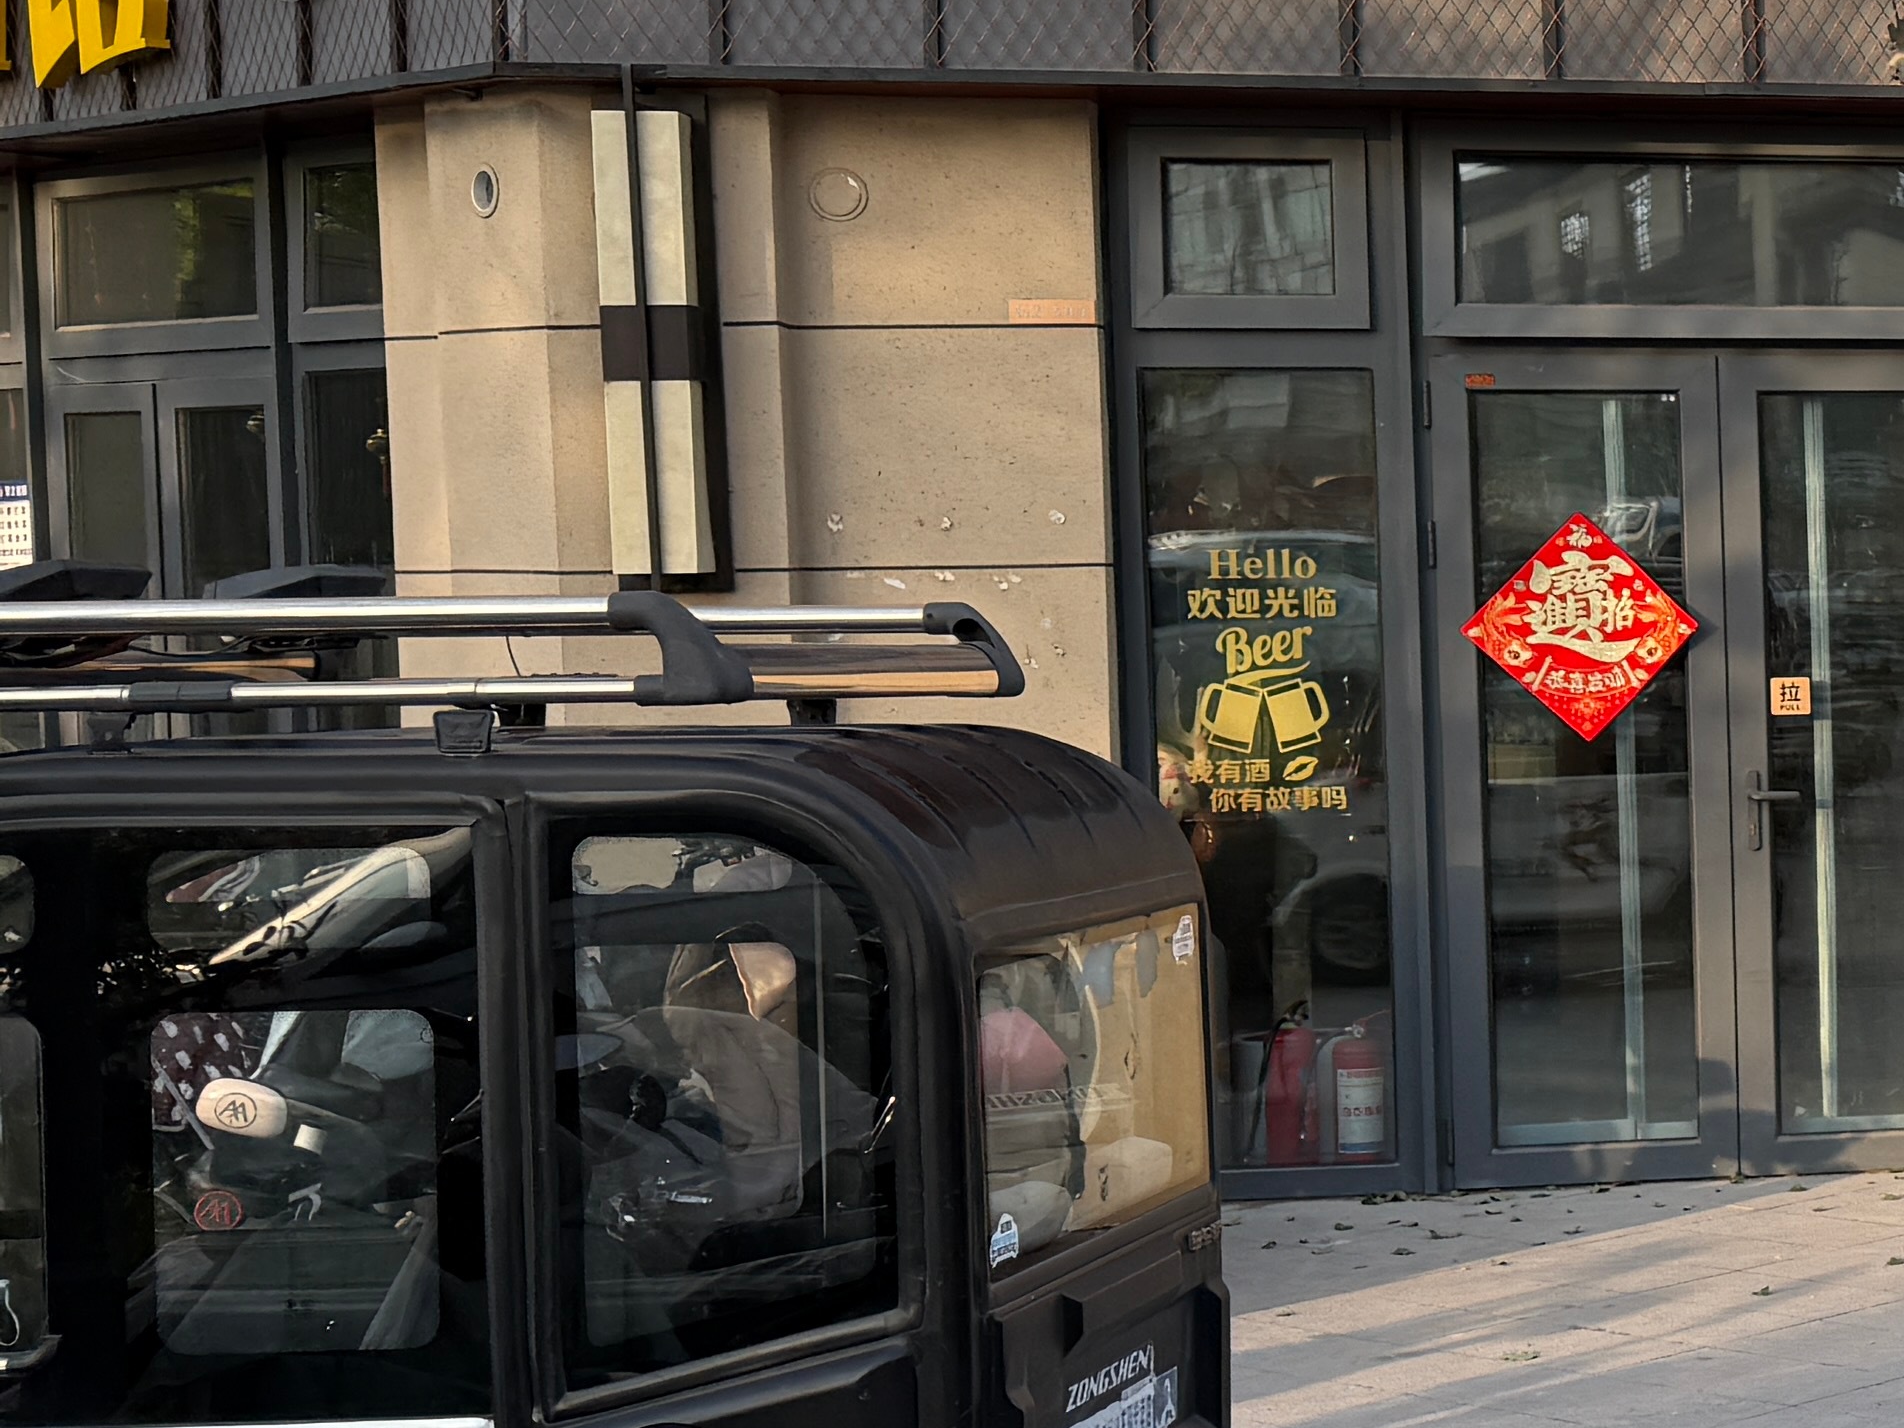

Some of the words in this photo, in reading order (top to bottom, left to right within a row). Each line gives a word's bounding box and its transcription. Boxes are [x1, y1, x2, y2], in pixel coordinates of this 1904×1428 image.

[1209, 548, 1316, 580] Hello
[1187, 587, 1337, 620] 欢迎光临
[1216, 625, 1313, 674] Beer
[1779, 680, 1801, 702] 拉
[1187, 758, 1271, 785] 我有酒
[1209, 786, 1349, 813] 你有故事吗
[1065, 1345, 1151, 1413] ZONGSHEN
